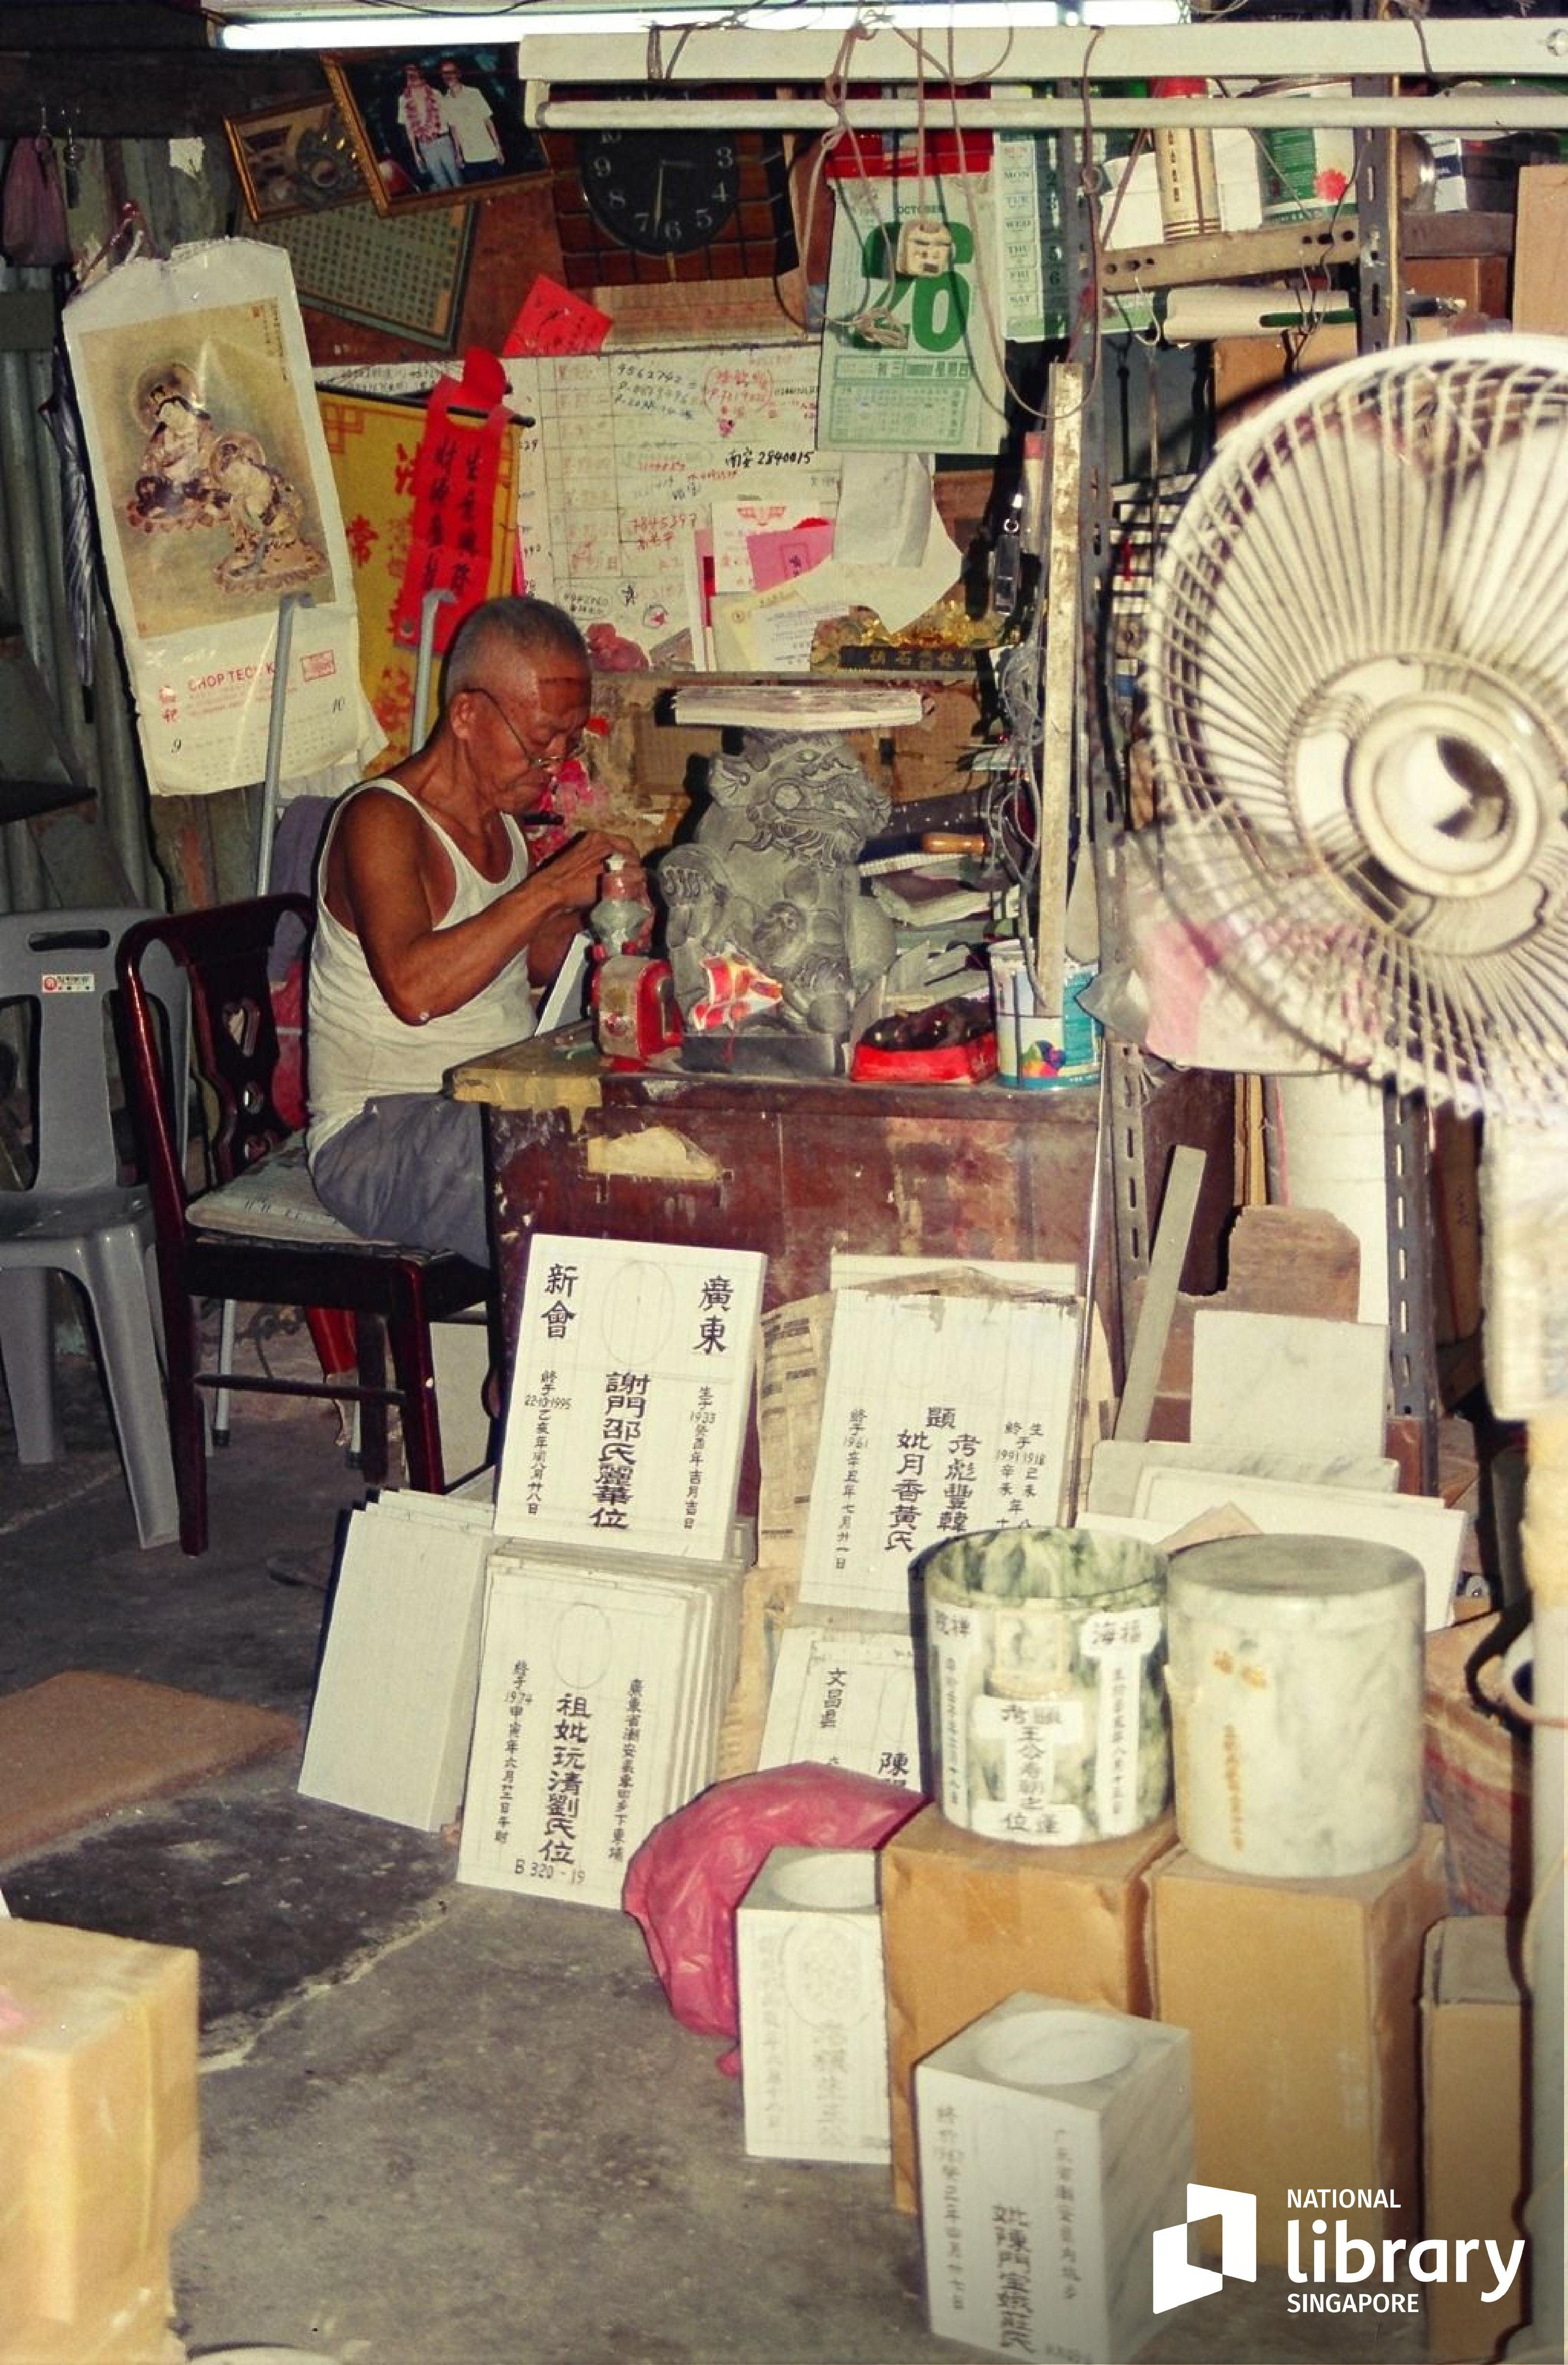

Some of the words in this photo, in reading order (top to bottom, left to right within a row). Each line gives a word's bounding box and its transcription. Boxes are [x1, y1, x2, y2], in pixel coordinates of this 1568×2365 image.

[593, 157, 612, 177] 9
[715, 146, 734, 168] 3
[713, 181, 728, 202] 4
[634, 212, 649, 232] 7
[696, 208, 712, 228] 5
[663, 221, 682, 240] 6
[188, 673, 224, 692] CHOP
[228, 664, 262, 683] TEC
[332, 697, 345, 713] 10
[171, 738, 182, 755] 9
[541, 1264, 579, 1339] 新會
[693, 1275, 734, 1355] 廣東
